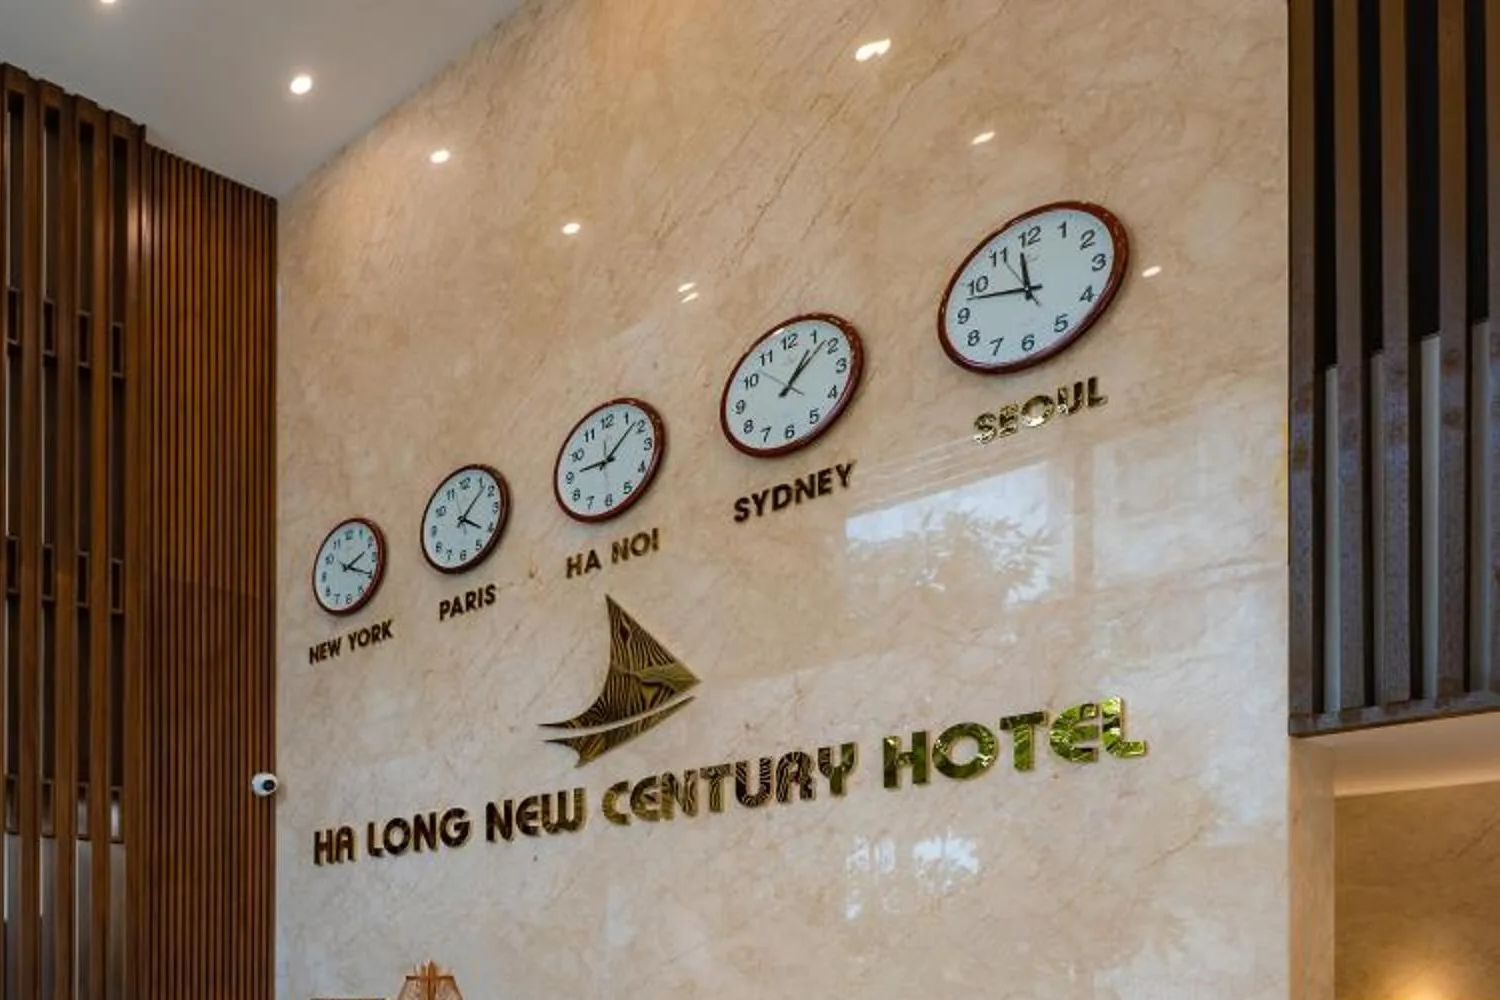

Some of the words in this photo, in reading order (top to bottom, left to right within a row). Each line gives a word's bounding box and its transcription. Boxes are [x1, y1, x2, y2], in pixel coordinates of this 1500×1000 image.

[1019, 226, 1041, 248] 12
[1058, 221, 1067, 239] 1
[1080, 229, 1095, 250] 2
[988, 248, 1008, 267] 11
[1092, 253, 1106, 272] 3
[967, 275, 989, 295] 10
[1080, 285, 1095, 302] 4
[958, 307, 970, 324] 9
[1054, 314, 1068, 333] 5
[781, 332, 798, 350] 12
[810, 330, 817, 344] 1
[967, 330, 980, 346] 8
[1022, 334, 1035, 351] 6
[827, 337, 839, 354] 2
[990, 338, 1004, 356] 7
[759, 350, 773, 366] 11
[836, 358, 847, 374] 3
[744, 373, 759, 390] 10
[828, 385, 838, 400] 4
[736, 400, 746, 415] 9
[973, 376, 1108, 444] SEOUL
[601, 414, 614, 430] 12
[624, 412, 629, 424] 1
[810, 408, 820, 424] 5
[636, 420, 645, 433] 2
[744, 419, 754, 434] 8
[761, 427, 772, 442] 7
[785, 424, 795, 439] 6
[584, 428, 594, 442] 11
[644, 437, 652, 451] 3
[571, 448, 584, 462] 10
[638, 461, 645, 473] 4
[566, 471, 574, 484] 9
[447, 488, 454, 500] 11
[572, 488, 580, 501] 8
[624, 481, 632, 494] 5
[734, 460, 856, 523] SYDNEY
[586, 496, 594, 509] 7
[605, 494, 612, 507] 6
[476, 539, 482, 550] 5
[447, 549, 452, 560] 7
[566, 549, 602, 579] HA
[612, 527, 660, 564] NOI
[439, 584, 496, 621] PARIS
[309, 636, 343, 665] NEW
[348, 619, 393, 651] YORK
[313, 825, 357, 866] HA
[367, 807, 471, 858] LONG
[485, 787, 587, 843] NEW
[602, 741, 858, 826] CENTURY
[882, 695, 1148, 789] HOTEL
